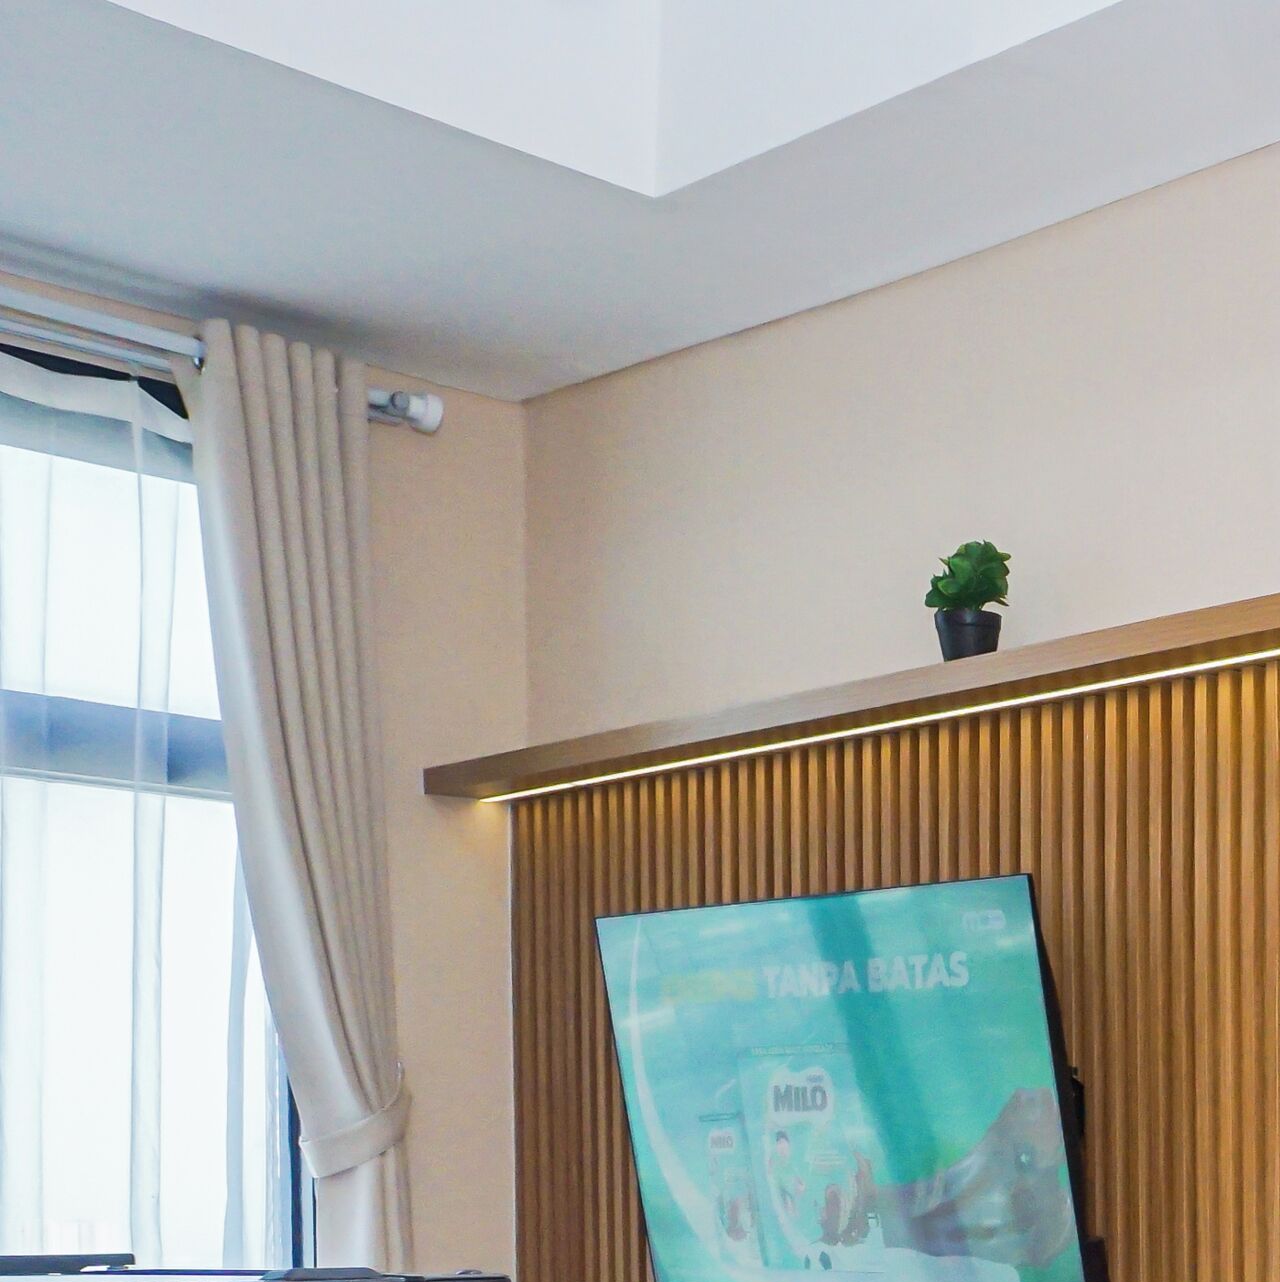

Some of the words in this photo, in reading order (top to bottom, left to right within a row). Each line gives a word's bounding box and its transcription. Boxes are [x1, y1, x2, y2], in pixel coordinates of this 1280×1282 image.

[763, 960, 862, 999] TANPA
[867, 950, 970, 993] BATAS
[773, 1084, 828, 1113] MILO
